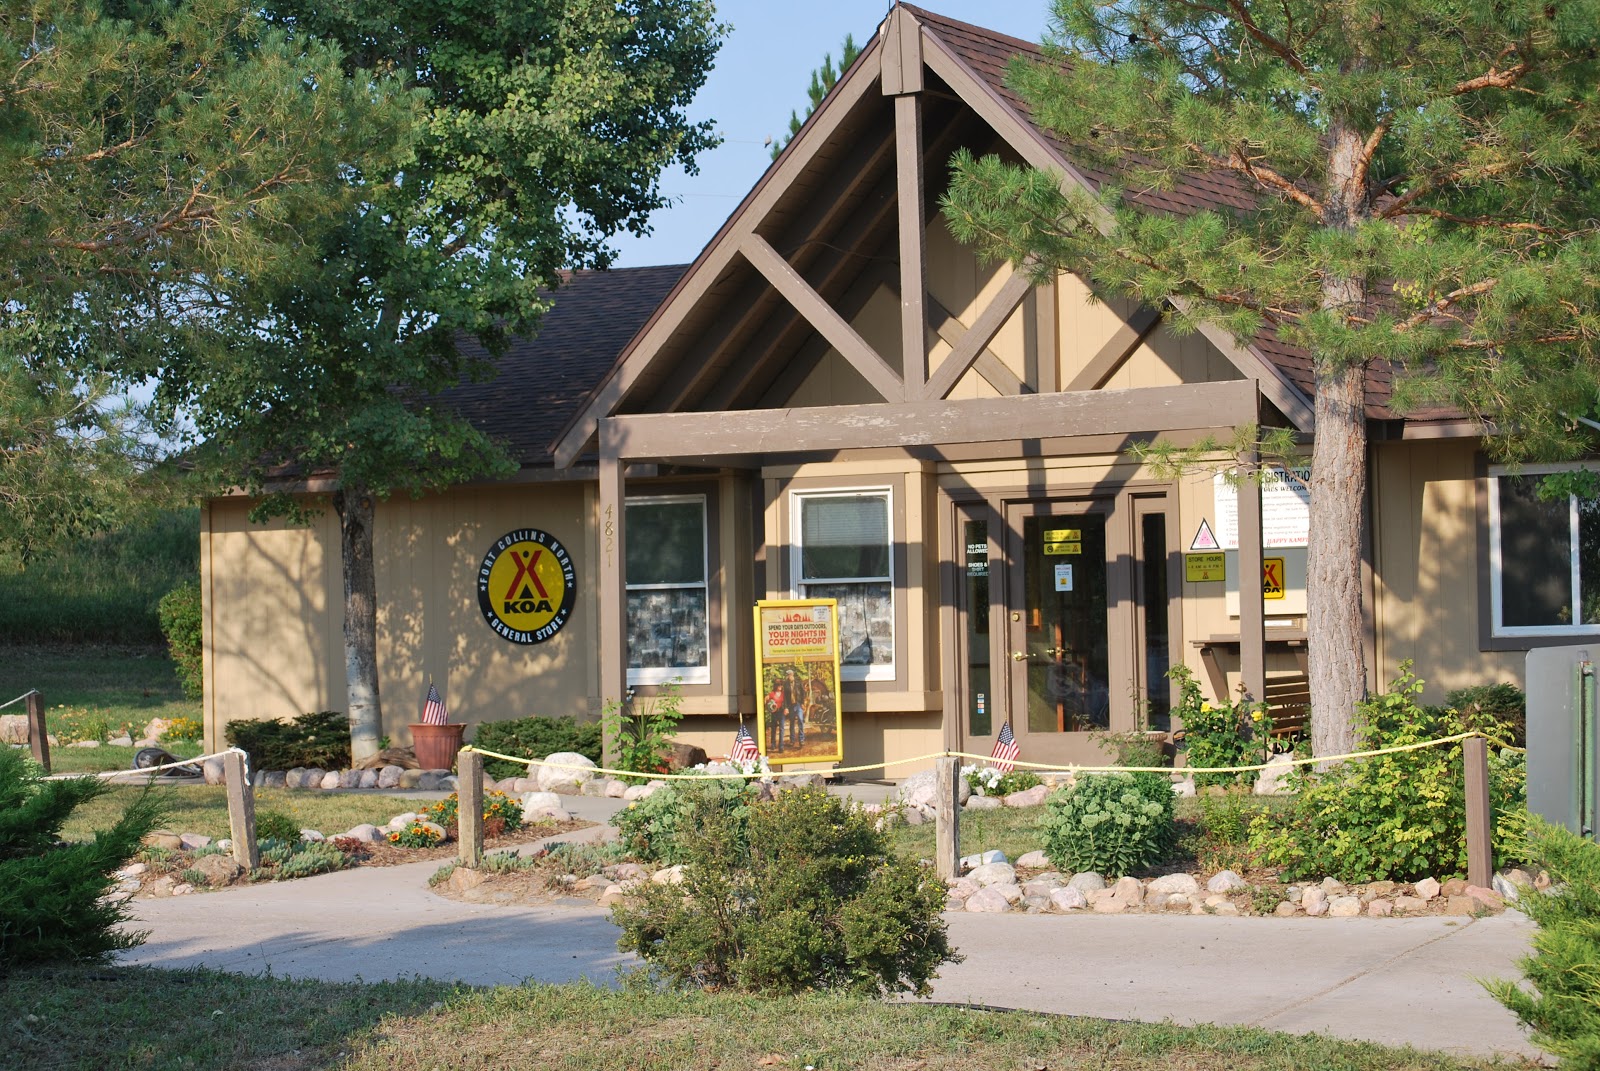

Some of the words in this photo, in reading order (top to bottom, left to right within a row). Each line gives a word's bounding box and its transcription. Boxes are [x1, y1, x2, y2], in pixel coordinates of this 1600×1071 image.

[604, 503, 614, 568] 4821
[480, 551, 496, 584] FORT
[498, 530, 546, 550] COLLINS
[550, 541, 574, 581] NORTH
[504, 600, 553, 614] KOA
[491, 618, 532, 642] GENERAL
[536, 616, 563, 641] STORE
[791, 630, 817, 638] NIGHTS
[818, 629, 826, 637] IN
[769, 638, 789, 646] COZY
[791, 637, 826, 645] COMFORT
